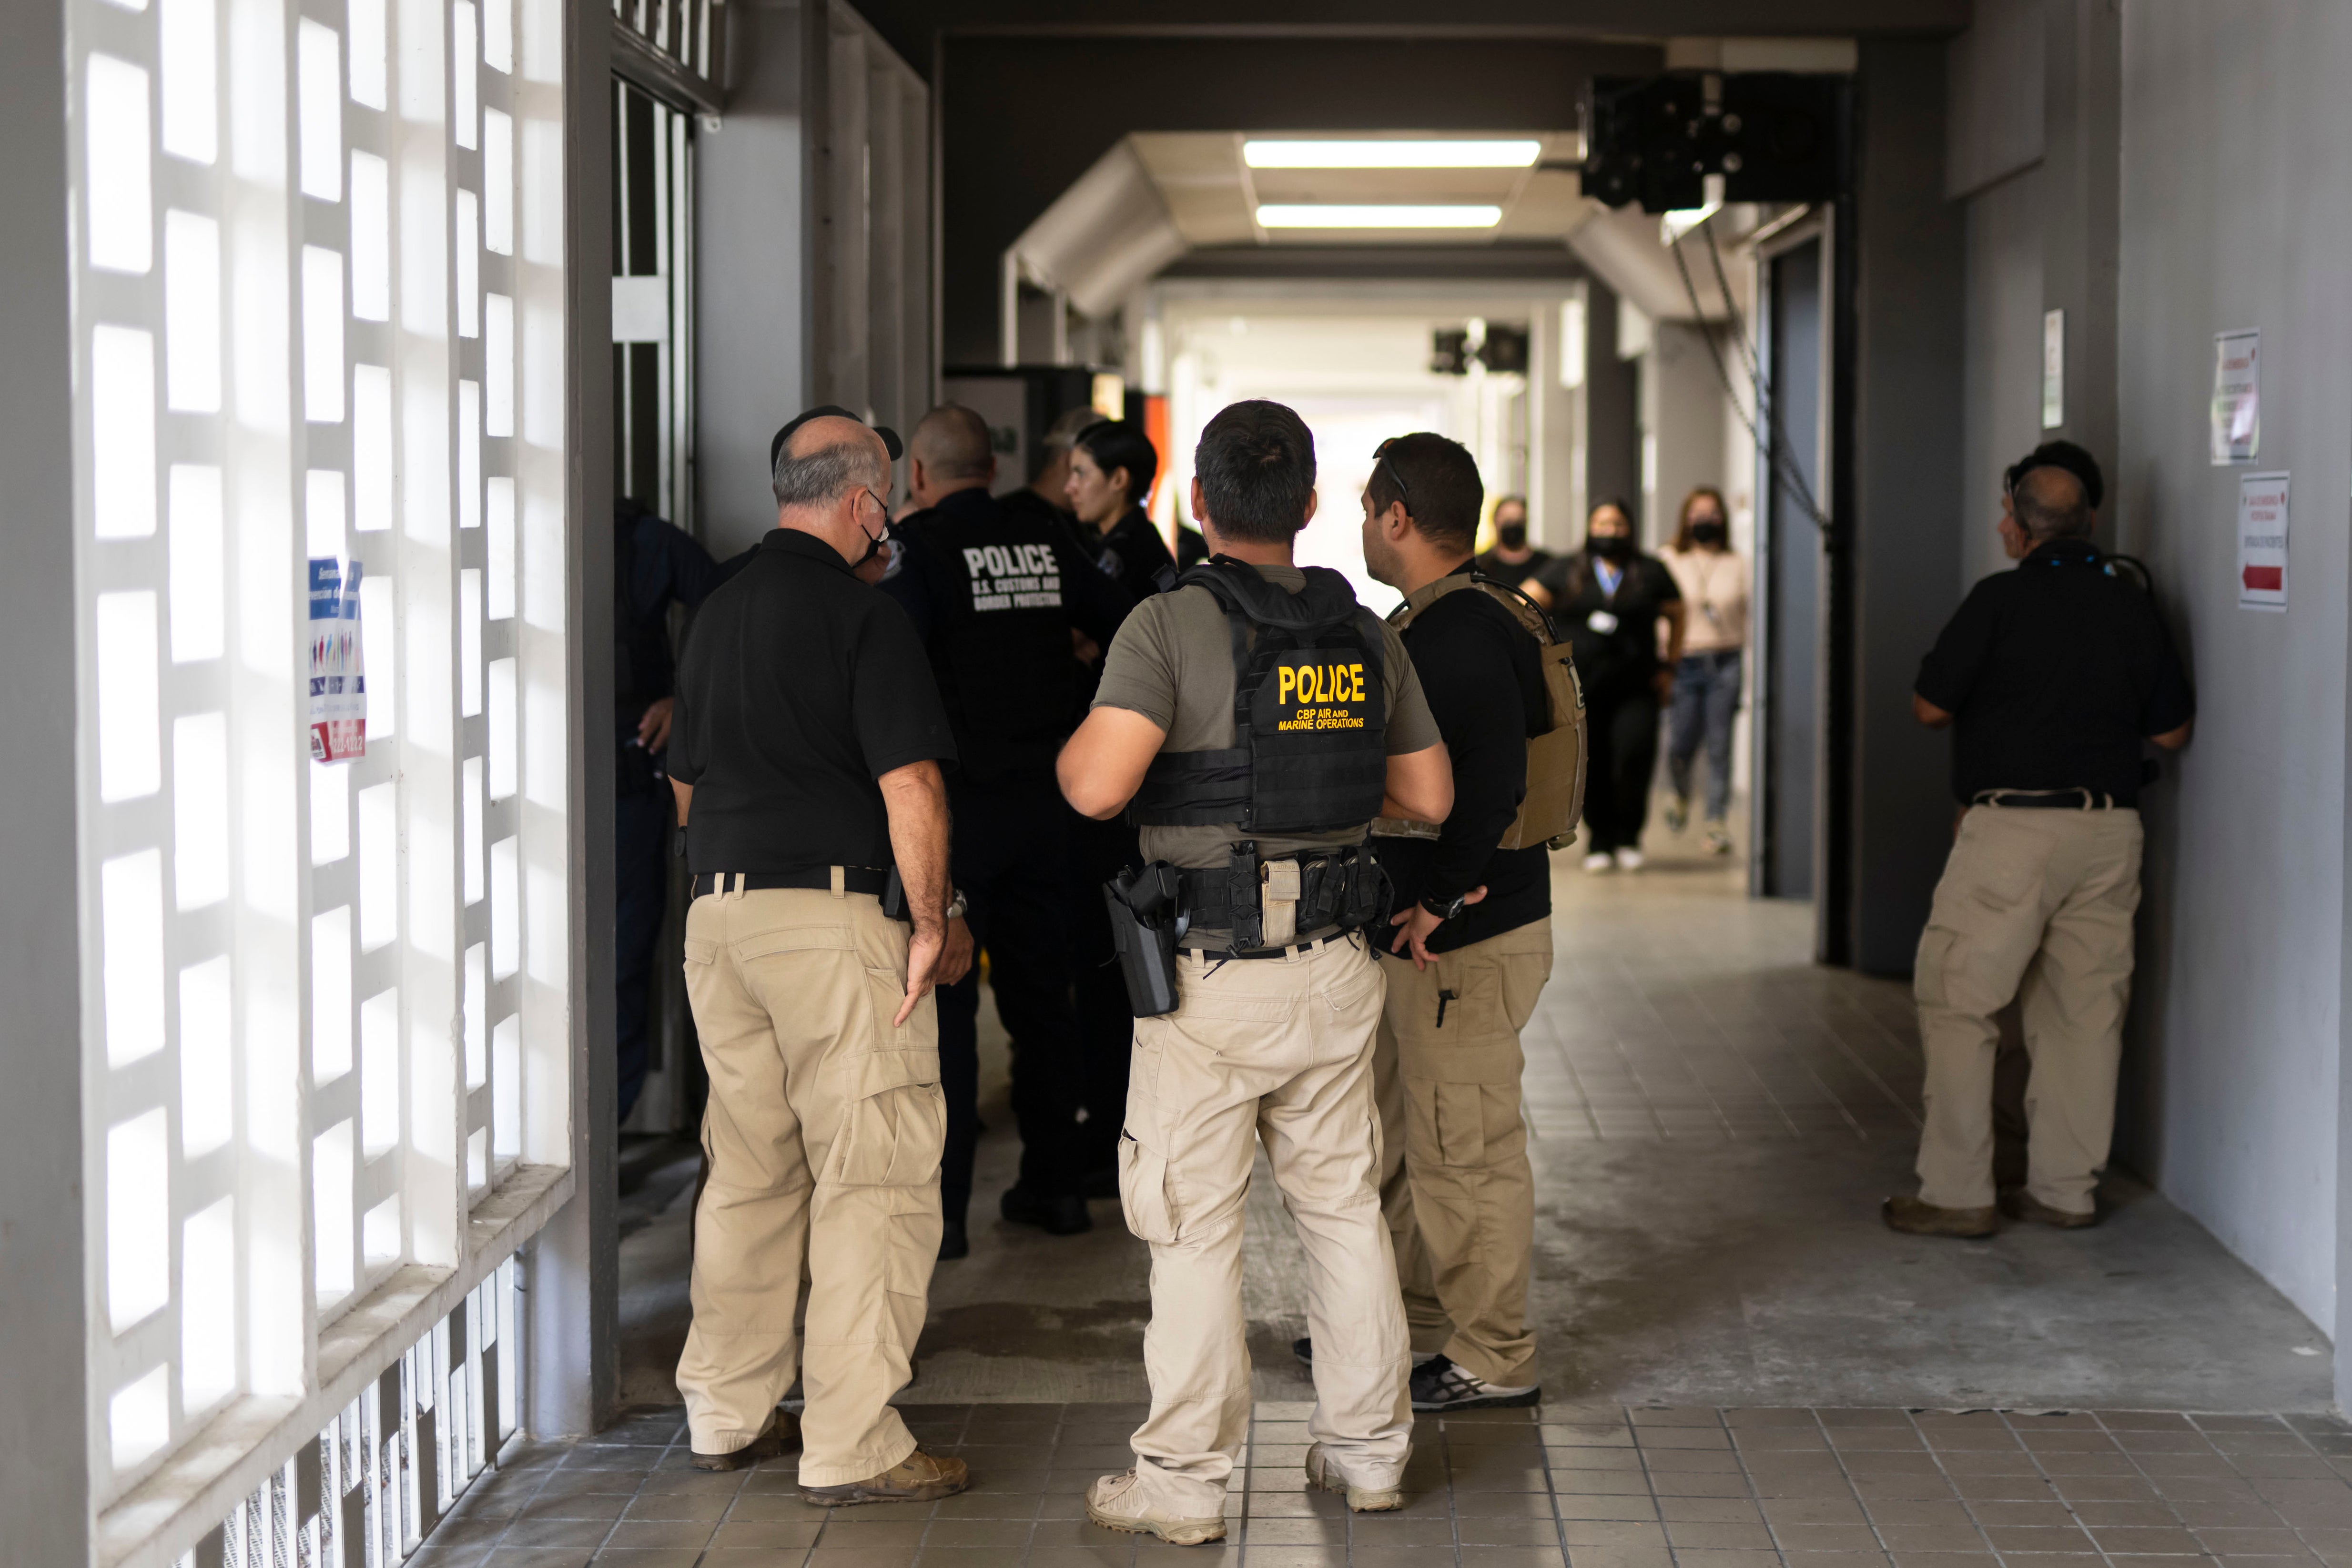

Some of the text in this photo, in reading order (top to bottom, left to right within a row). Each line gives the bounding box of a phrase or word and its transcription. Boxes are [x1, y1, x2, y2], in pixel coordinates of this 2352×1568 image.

[963, 544, 1059, 578] POLICE
[1278, 664, 1365, 704] POLICE
[1278, 718, 1364, 730] MARINE OPERATIONS
[1297, 709, 1316, 720] CBP
[1318, 708, 1331, 718] AIR
